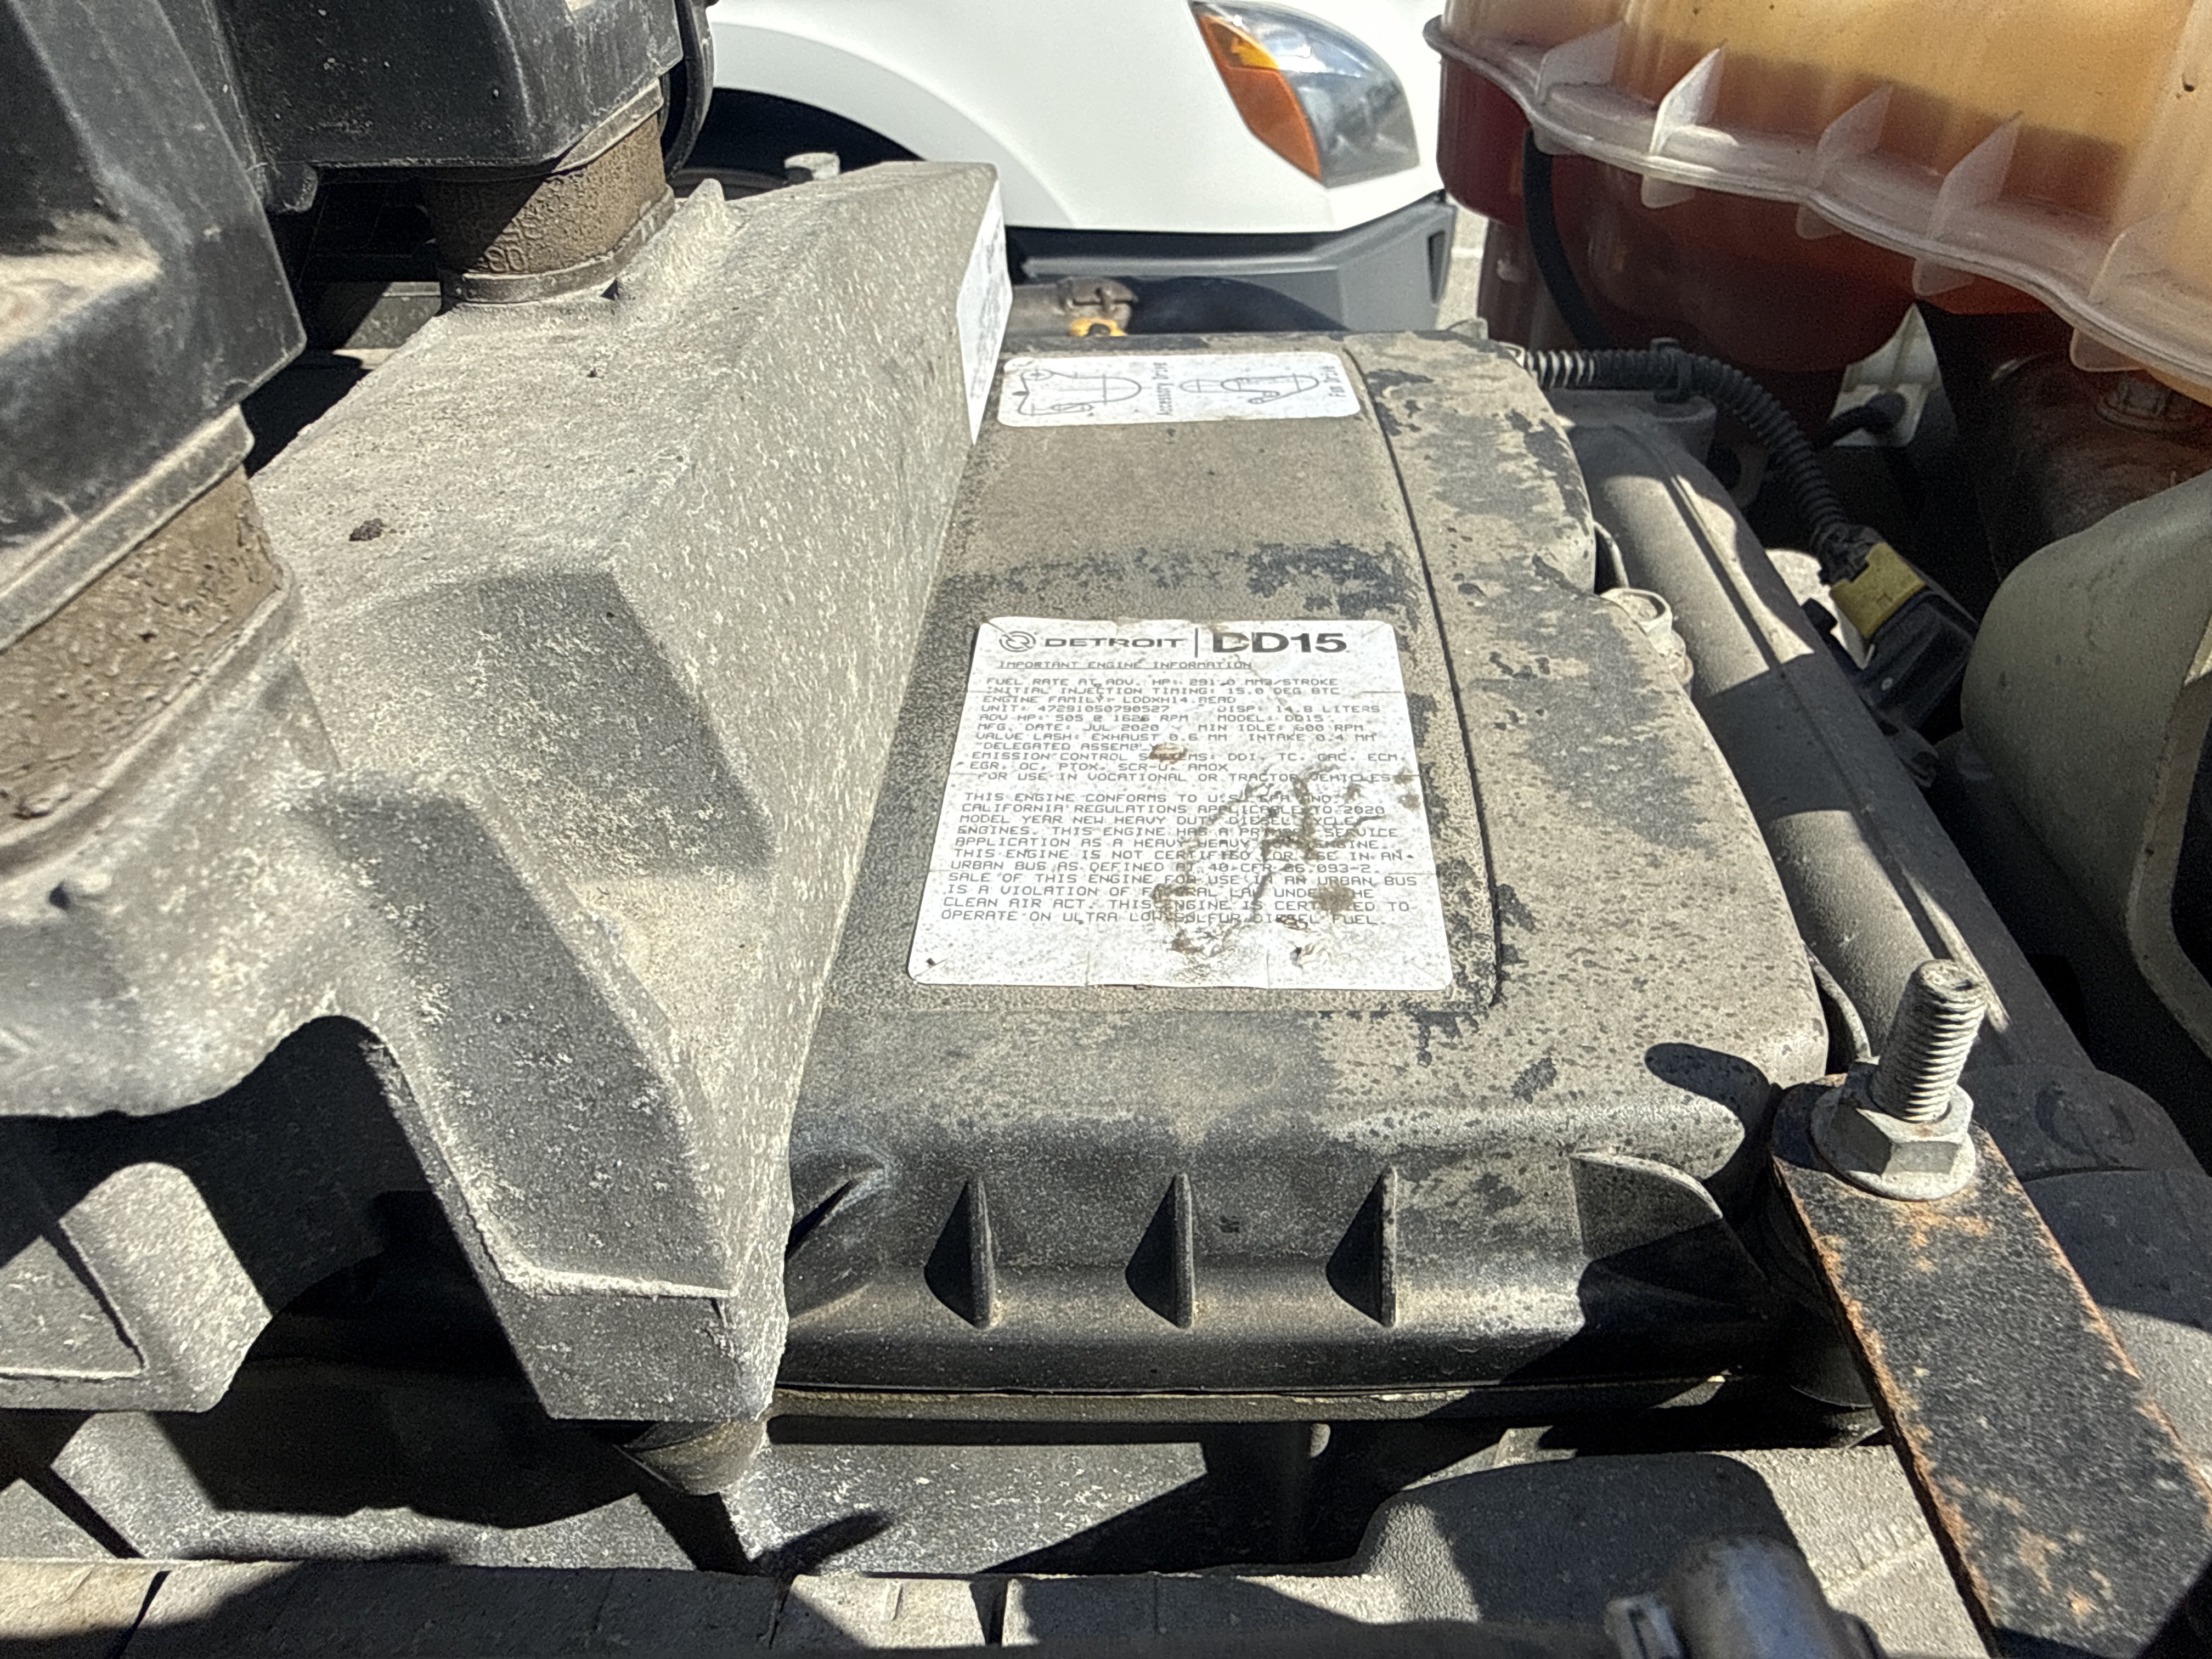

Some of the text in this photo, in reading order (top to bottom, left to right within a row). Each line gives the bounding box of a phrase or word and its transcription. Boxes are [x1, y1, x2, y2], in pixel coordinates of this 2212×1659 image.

[1320, 365, 1341, 383] Drive
[1152, 362, 1175, 416] Accessory Drive
[1045, 632, 1347, 653] DETROIT DD15
[978, 723, 1364, 732] MFG. DATE: JUL 2020 MIN IDLE: 600 RPM
[975, 732, 1023, 741] VALVE
[1169, 733, 1197, 741] 0.6
[1208, 733, 1227, 741] MM
[1081, 743, 1154, 751] ASSEMBL
[972, 752, 1051, 760] EMISSION
[1060, 752, 1128, 761] CONTROL
[1188, 762, 1228, 771] AMOX
[977, 772, 1391, 782] FOR USE IN VOCATIONAL OR TRACTOR VEHICLES
[965, 792, 1004, 802] THIS
[1014, 793, 1075, 802] ENGINE
[1085, 793, 1167, 803] CONFORMS
[1180, 794, 1197, 803] TO
[962, 804, 1063, 813] CALIFORNIA
[1074, 804, 1187, 814] REGULATIONS
[1312, 805, 1333, 814] TO
[1344, 806, 1385, 815] 2020
[960, 814, 1354, 825] MODEL YEAR NEW HEAVY DUTY DIESEL YCLE
[957, 826, 1398, 838] ENGINES. THIS ENGINE HAS A SERVICE
[955, 838, 1070, 847] APPLICATION
[1081, 838, 1102, 848] AS
[1113, 838, 1122, 848] A
[1134, 839, 1183, 848] HEAVY
[1198, 839, 1250, 848] HEAVY
[955, 848, 995, 858] THIS
[1006, 849, 1069, 859] ENGINE
[1082, 849, 1101, 859] IS
[1112, 850, 1143, 859] NOT
[1351, 851, 1370, 861] IN
[1381, 851, 1403, 861] AN
[951, 860, 1003, 870] URBAN
[1014, 861, 1047, 871] BUS
[1057, 861, 1079, 871] AS
[1090, 862, 1164, 872] DEFINED
[1175, 862, 1193, 872] AT
[1208, 862, 1229, 872] 40
[1240, 862, 1272, 872] CFR
[949, 872, 991, 882] SALE
[1002, 873, 1023, 883] OF
[1036, 873, 1077, 883] THIS
[1088, 874, 1153, 884] ENGINE
[1207, 874, 1239, 884] USE
[1255, 875, 1273, 885] IN
[1284, 876, 1307, 885] AN
[1317, 876, 1372, 885] URBAN
[1384, 876, 1417, 886] BUS
[947, 884, 1330, 898] IS A VIOLATION OF UNDE
[943, 896, 1409, 911] CLEAN AIR ACT. THIS NGINE IS TO
[941, 910, 1018, 921] OPERATE
[1029, 911, 1051, 921] ON
[1063, 911, 1118, 922] ULTRA
[1130, 912, 1163, 922] LOW
[1175, 912, 1241, 923] SULFUR
[1332, 914, 1386, 924] FUEL.
